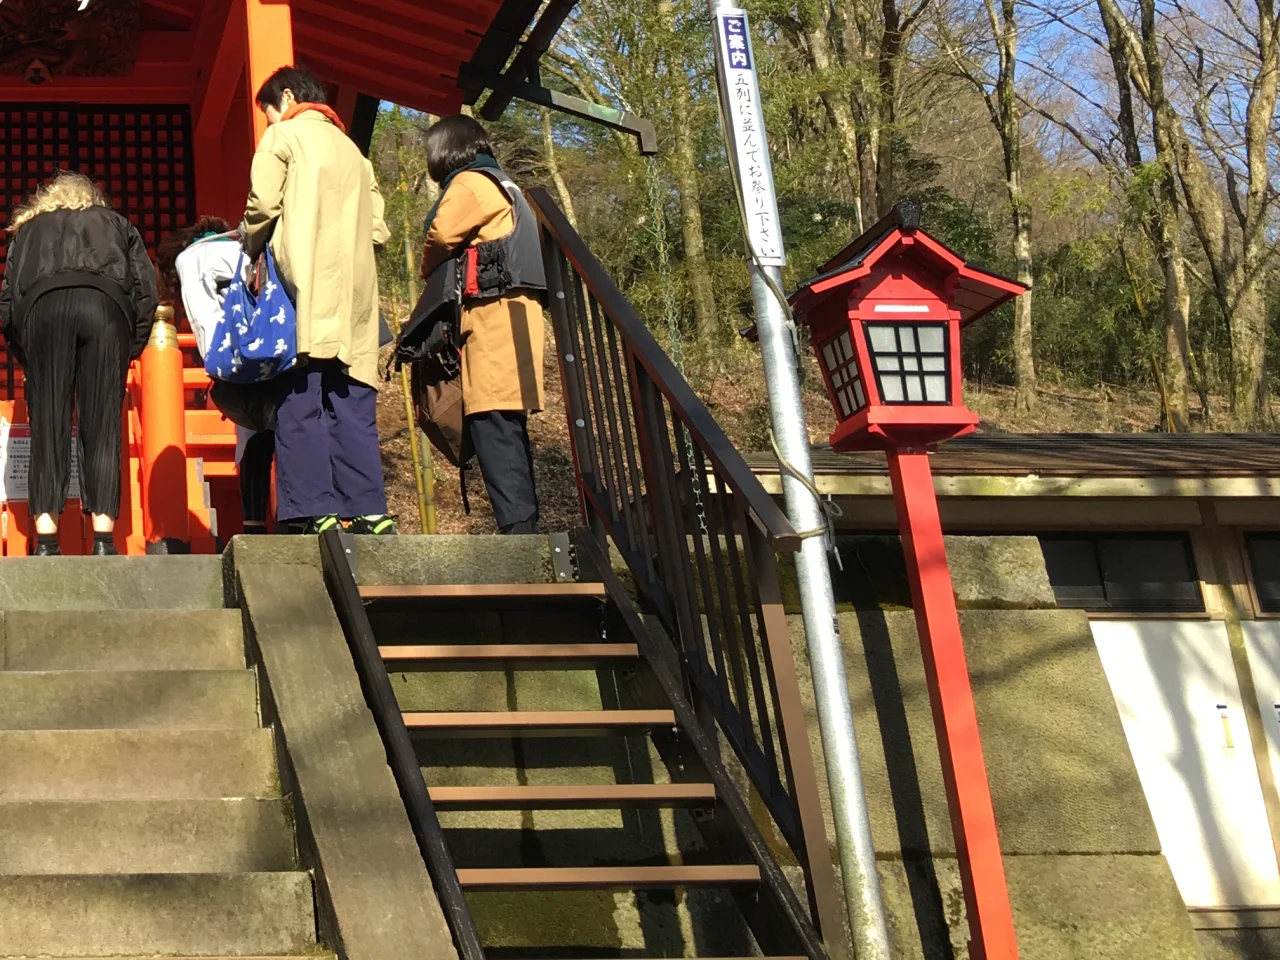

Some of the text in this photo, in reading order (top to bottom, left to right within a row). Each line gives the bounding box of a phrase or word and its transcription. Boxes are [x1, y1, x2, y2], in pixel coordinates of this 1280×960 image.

[727, 19, 748, 67] ご案内
[735, 73, 775, 257] 五列に並んでお参り下さい
